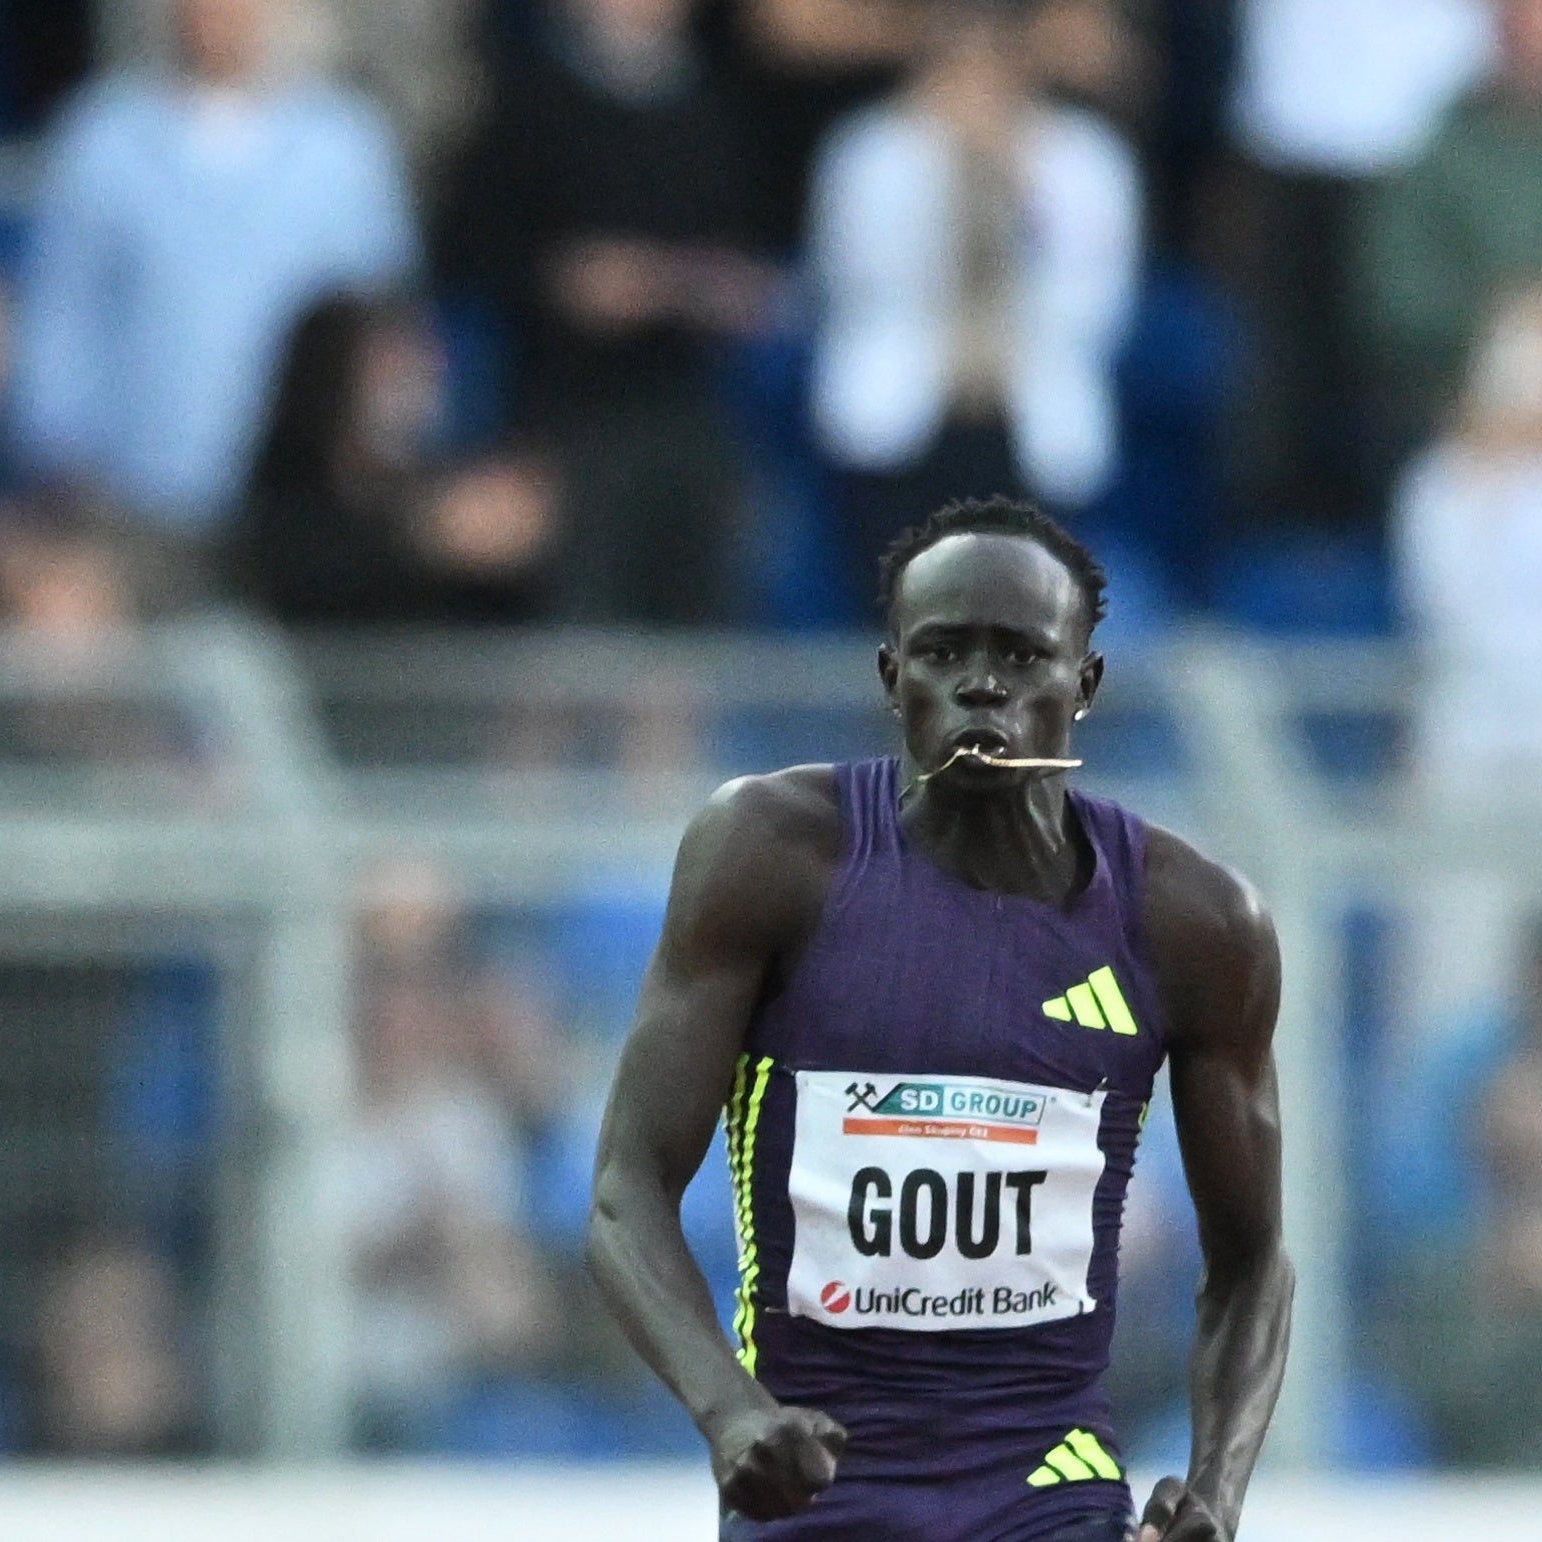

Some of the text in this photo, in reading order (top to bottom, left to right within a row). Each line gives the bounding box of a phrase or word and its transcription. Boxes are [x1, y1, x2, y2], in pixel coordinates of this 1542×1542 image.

[900, 1089, 1038, 1118] SD GROUP
[848, 1166, 1048, 1260] GOUT
[855, 1282, 1057, 1317] UniCredit Bank
